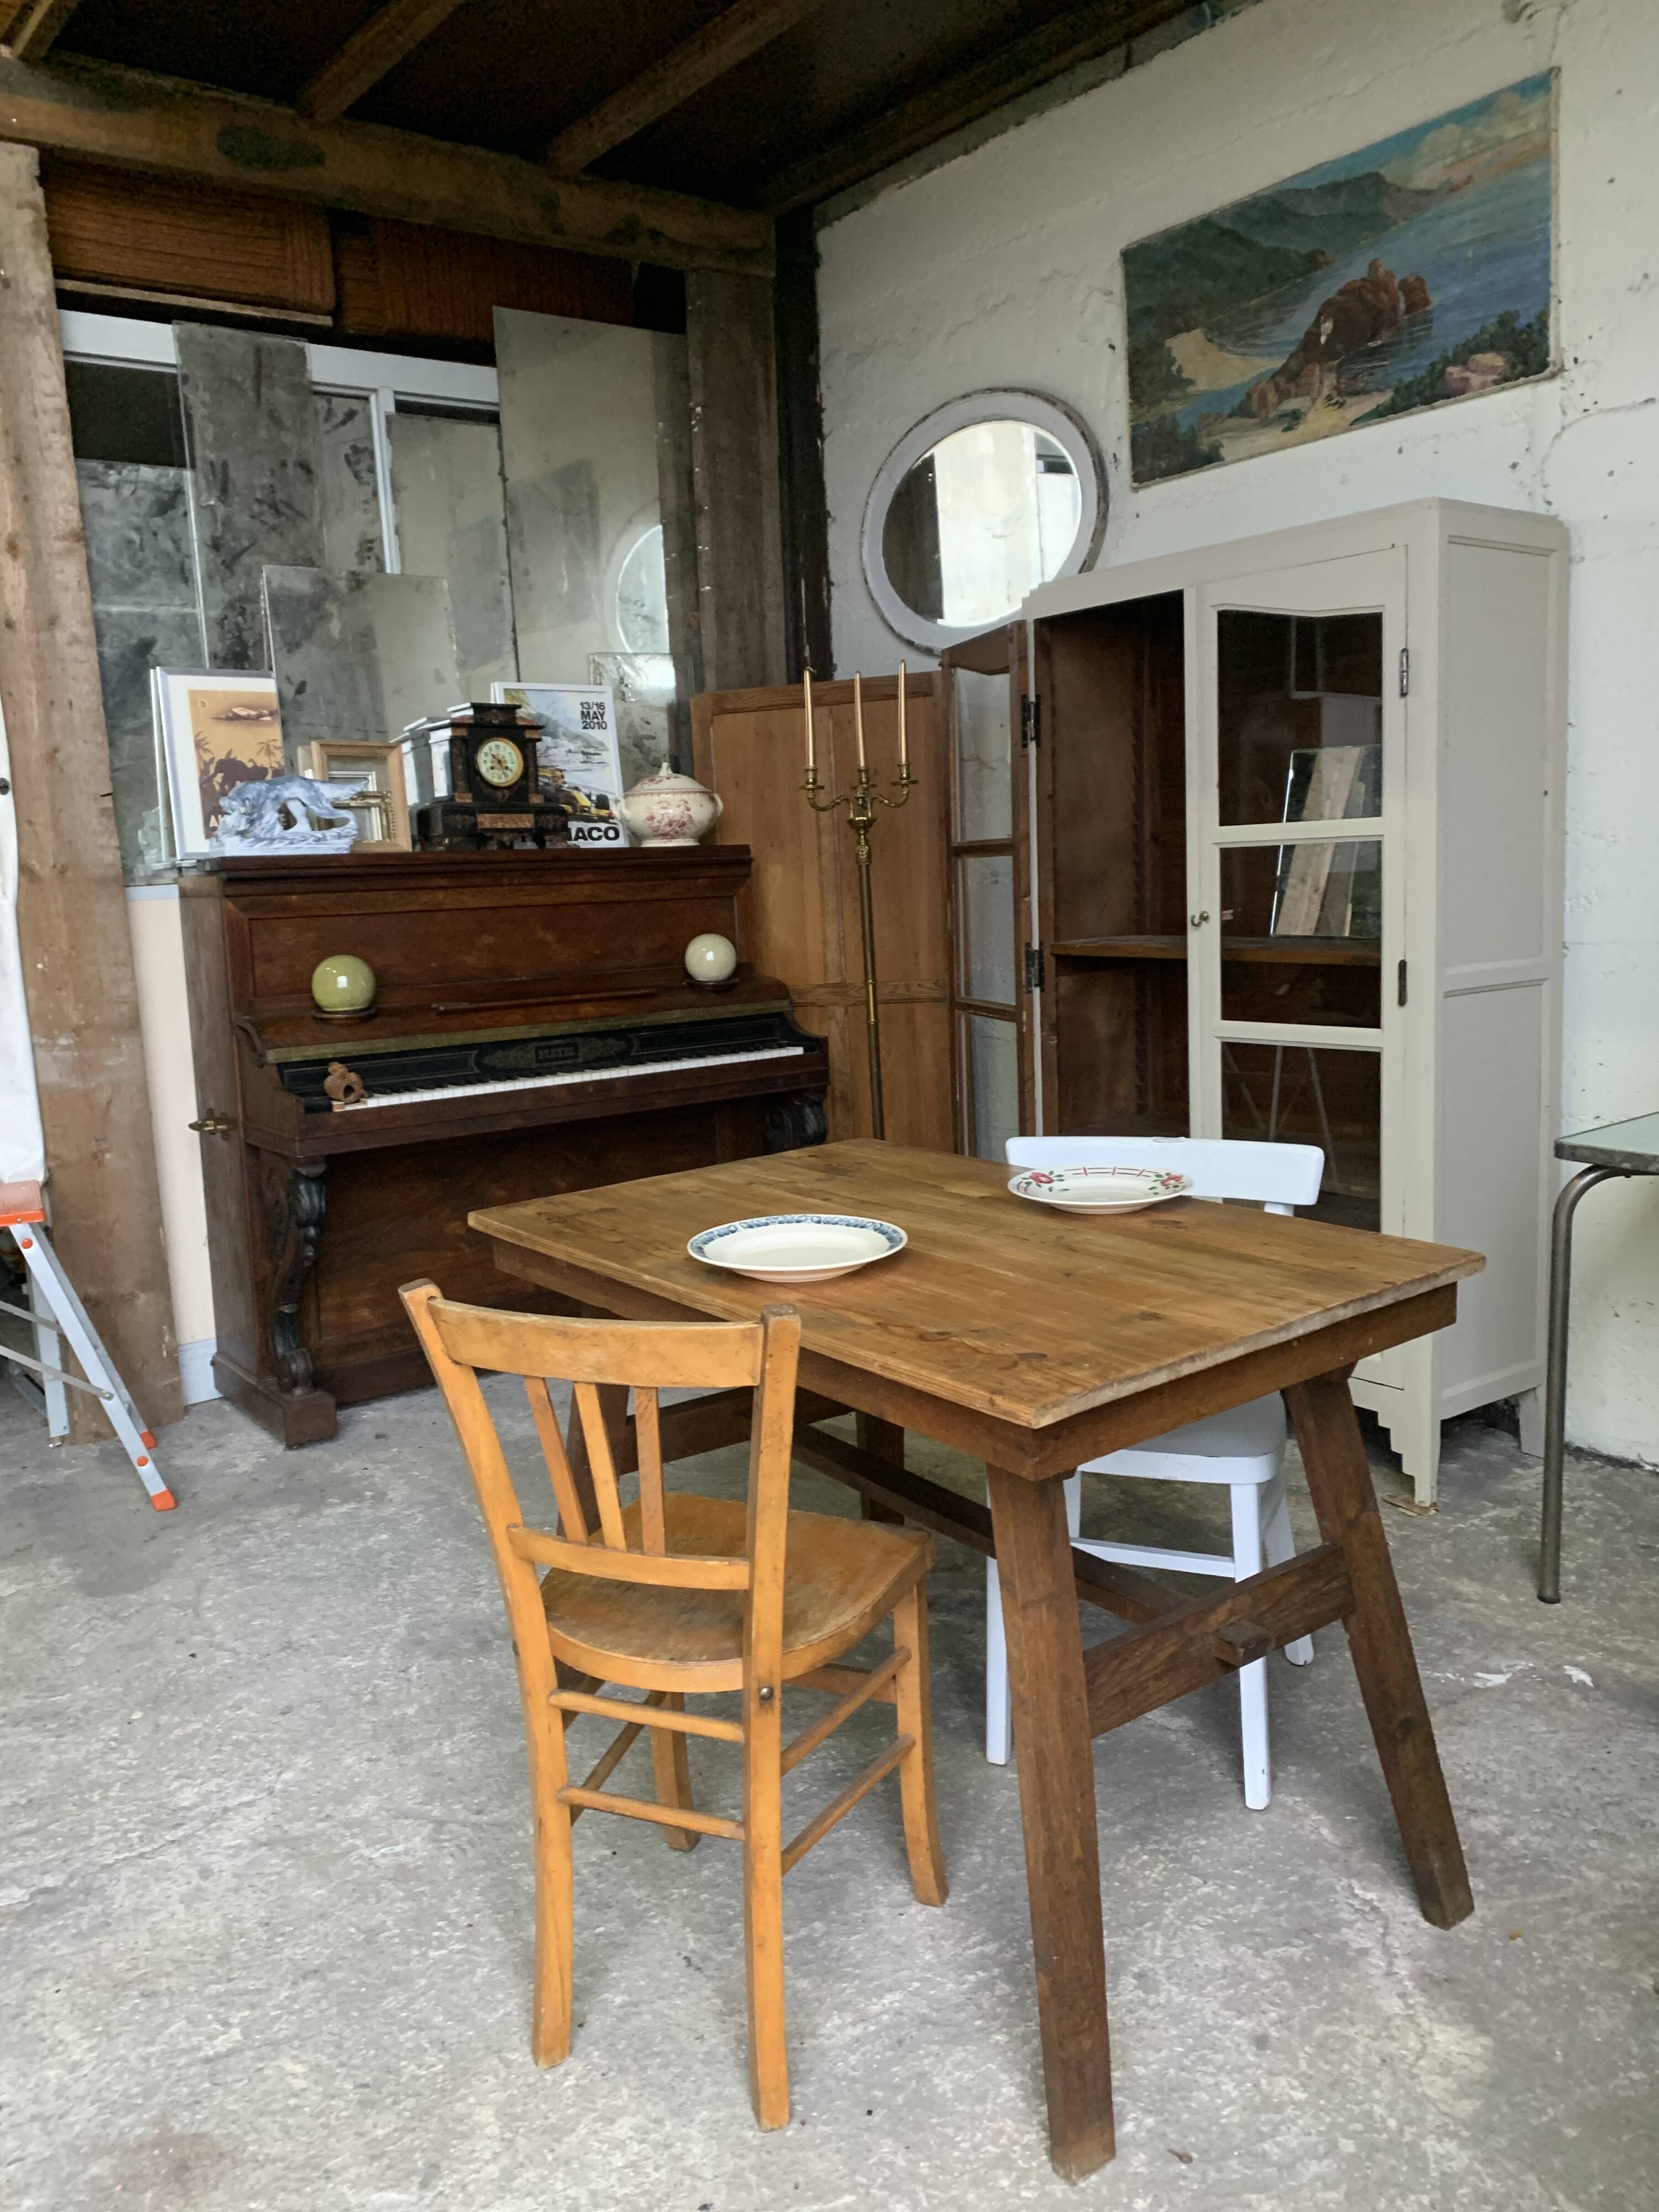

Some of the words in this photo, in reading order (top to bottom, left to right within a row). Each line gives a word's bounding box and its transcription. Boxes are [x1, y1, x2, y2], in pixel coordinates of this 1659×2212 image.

[580, 701, 606, 710] 13/16
[580, 710, 606, 720] MAY
[581, 720, 607, 730] 2010
